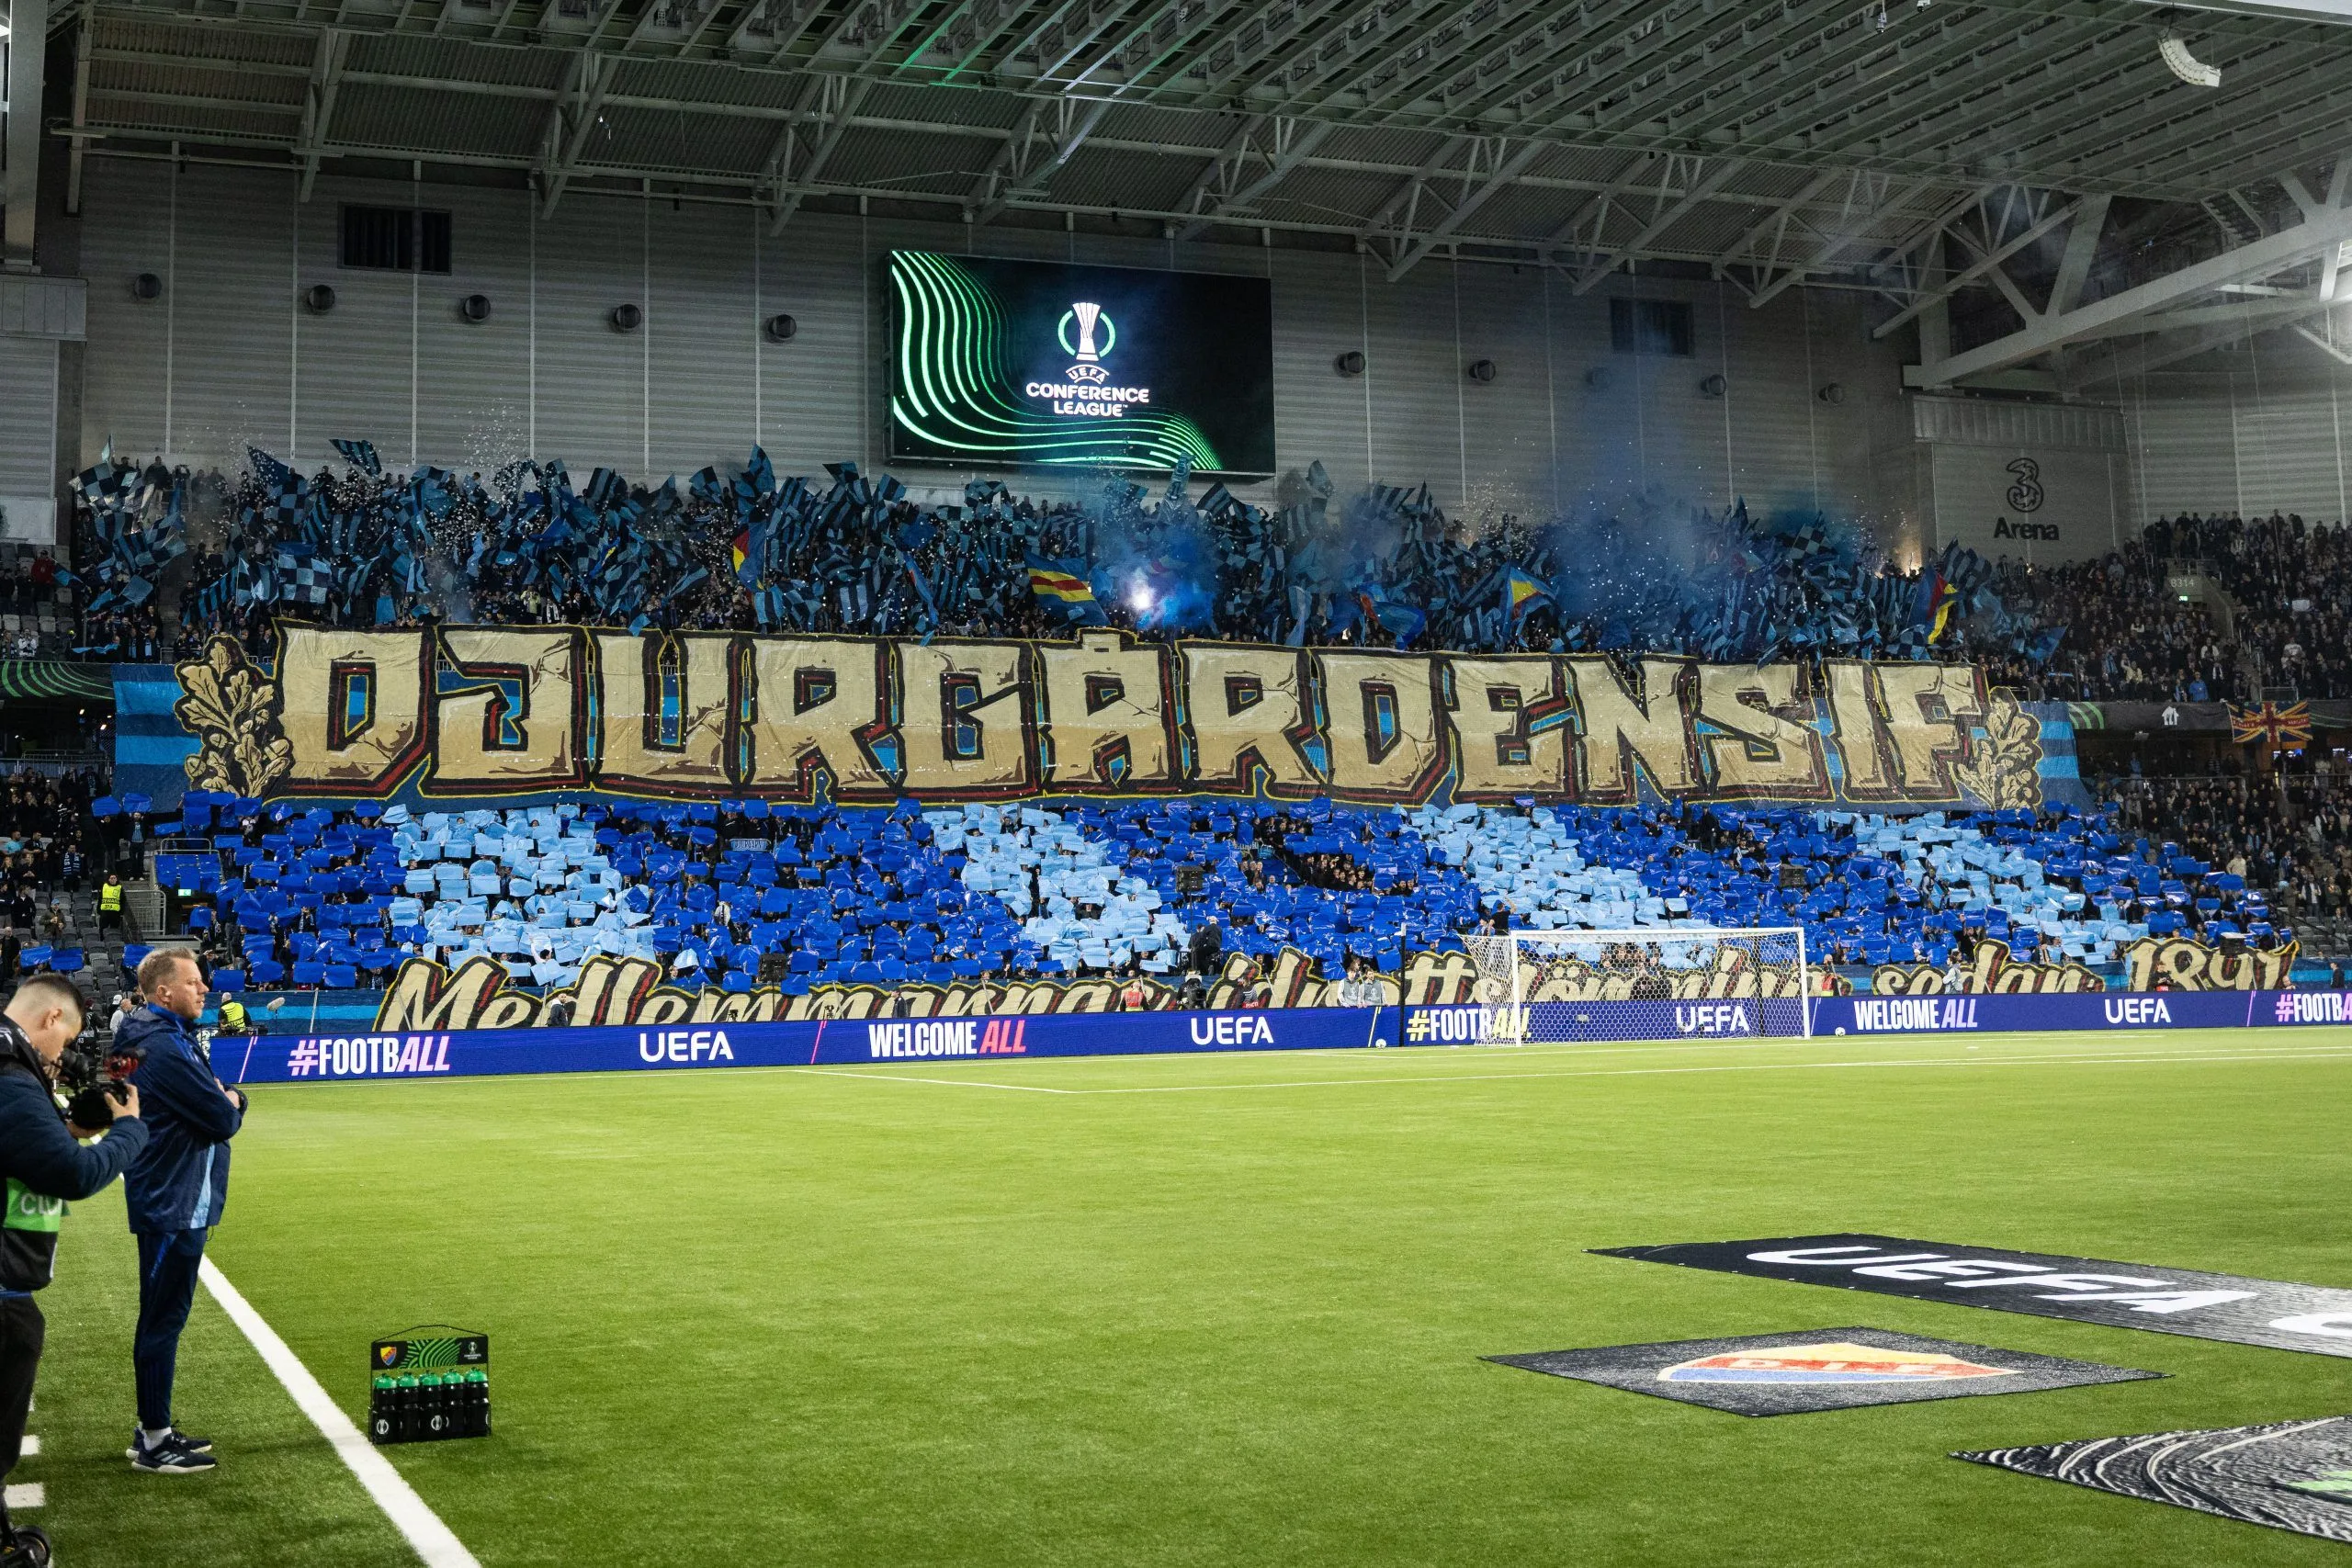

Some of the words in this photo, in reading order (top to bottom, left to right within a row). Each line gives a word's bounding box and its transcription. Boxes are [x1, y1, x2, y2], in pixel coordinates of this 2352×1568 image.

[1068, 367, 1106, 383] UEFA
[1025, 382, 1149, 402] CONFERENCE
[2007, 457, 2044, 513] 3
[1994, 517, 2060, 541] Arena
[1872, 938, 2106, 994] sedan
[2124, 937, 2300, 992] 1891
[1676, 1006, 1749, 1033] UEFA
[1853, 999, 1939, 1031] WELCOME
[1941, 998, 1978, 1028] ALL
[2105, 998, 2171, 1023] UEFA
[868, 1021, 978, 1057] WELCOME
[979, 1020, 1026, 1054] ALL
[1191, 1016, 1274, 1045] UEFA
[287, 1035, 450, 1077] #FOOTBALL
[639, 1031, 734, 1063] UEFA
[1747, 1246, 2257, 1314] UEFA
